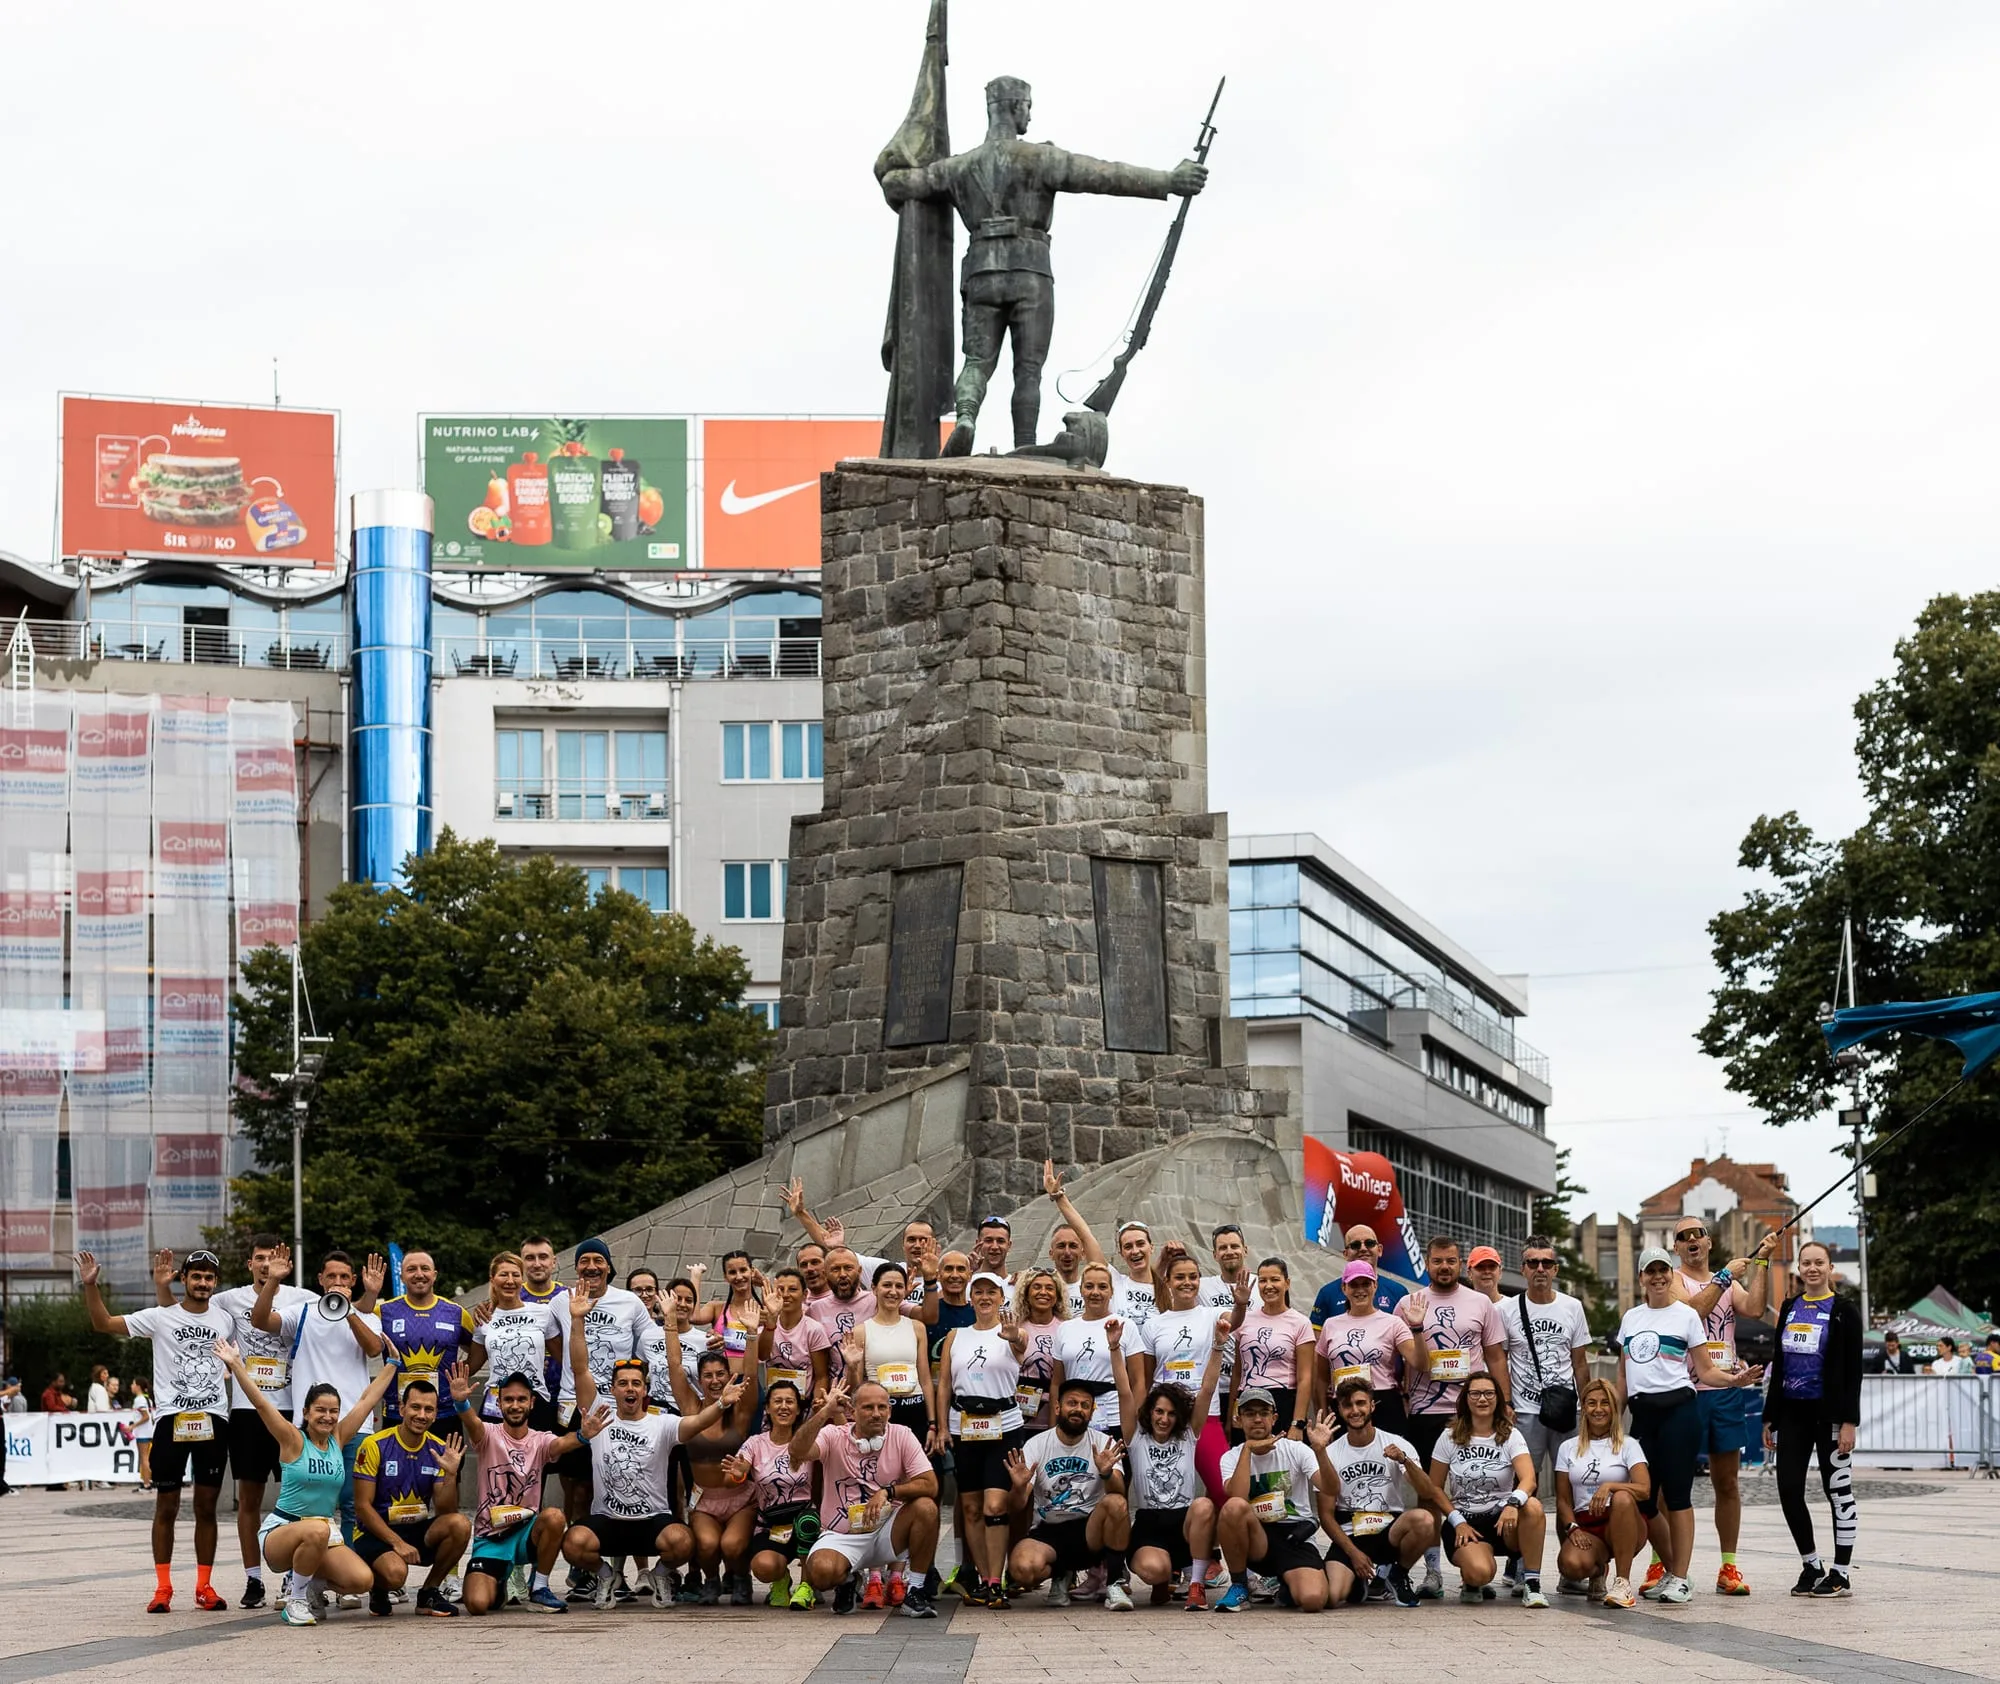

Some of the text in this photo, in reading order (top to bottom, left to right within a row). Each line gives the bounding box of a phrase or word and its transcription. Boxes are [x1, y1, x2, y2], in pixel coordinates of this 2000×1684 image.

[433, 426, 529, 437] NUTRINO LAB
[483, 446, 514, 454] SOURCE
[555, 473, 595, 483] MATCHA
[603, 473, 635, 483] PLENTY
[164, 532, 236, 550] ŠIR KO
[107, 728, 144, 741] SRMA
[25, 744, 63, 757] SRMA
[187, 838, 223, 849] SRMA
[21, 909, 57, 921] SRMA
[265, 918, 294, 930] SRMA
[187, 994, 221, 1005] SRMA
[181, 1149, 219, 1160] SRMA
[1340, 1163, 1392, 1197] RunTrace
[104, 1199, 141, 1213] SRMA
[9, 1225, 47, 1236] SRMA
[492, 1316, 536, 1329] 36SOMA
[585, 1311, 615, 1325] SOMA
[174, 1325, 219, 1342] 36SOMA
[1793, 1333, 1807, 1342] 870
[1442, 1360, 1459, 1369] 1192
[257, 1367, 274, 1376] 1123
[1175, 1371, 1190, 1380] 758
[172, 1393, 219, 1410] RUNNERS
[901, 1396, 922, 1406] NIKE
[187, 1422, 202, 1431] 1121
[972, 1421, 990, 1430] 1240
[1458, 1446, 1501, 1461] 36SOMA
[308, 1458, 334, 1475] BRC
[1047, 1457, 1089, 1476] 36SOMA
[1341, 1463, 1385, 1483] 36SOMA
[1256, 1502, 1273, 1513] 1196
[504, 1513, 522, 1523] 1003
